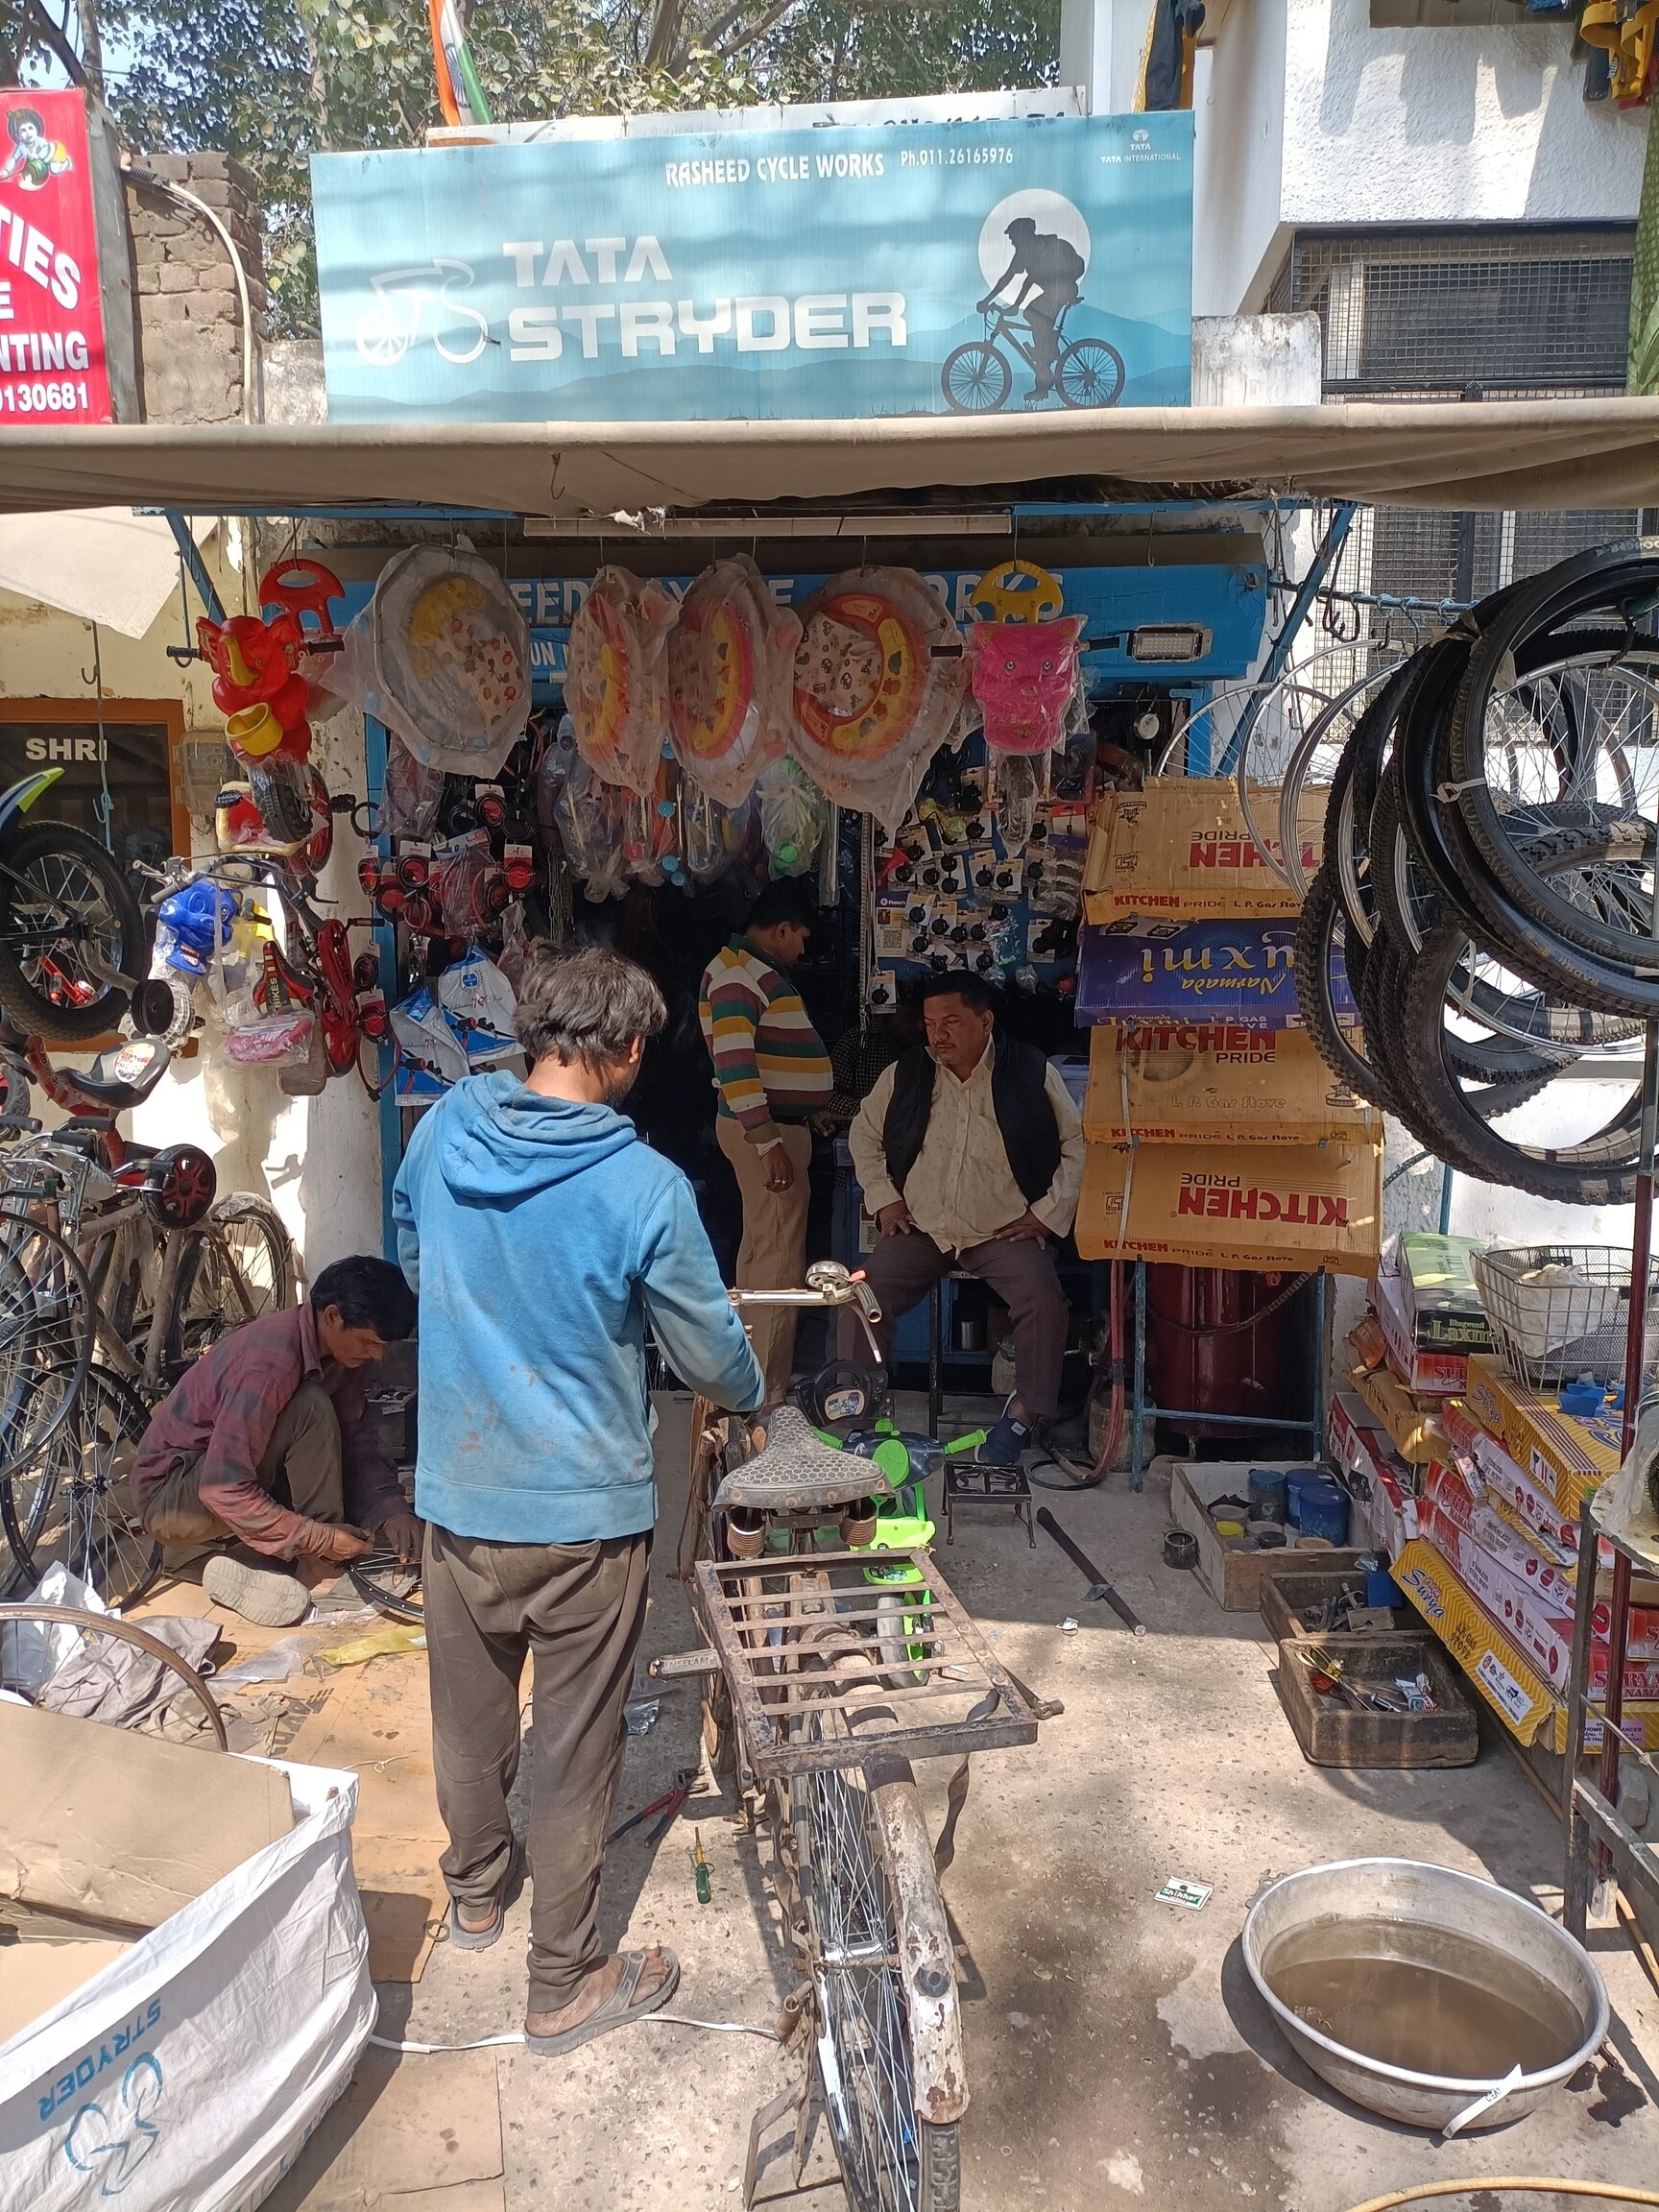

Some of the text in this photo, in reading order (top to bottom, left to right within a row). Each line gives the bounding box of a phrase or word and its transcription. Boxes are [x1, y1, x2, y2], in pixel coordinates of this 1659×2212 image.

[665, 147, 1014, 188] RASHEED CYCLE WORKS Ph.011.26165976
[1100, 153, 1181, 163] TATA INTERNATIONAL
[502, 235, 673, 287] TATA
[508, 292, 907, 362] STRYDER
[0, 381, 88, 412] 130681
[1114, 895, 1180, 908] KITCHEN
[1183, 900, 1226, 908] PRIDE
[1279, 900, 1304, 908] Stov
[273, 976, 282, 1008] BIKES
[1181, 973, 1286, 996] Narmada
[1238, 1015, 1268, 1023] GAS
[1115, 1025, 1276, 1052] KITCHEN
[1214, 1051, 1276, 1064] PRIDE
[1206, 1095, 1238, 1108] Gas
[1240, 1095, 1286, 1109] Stove
[1110, 1128, 1176, 1138] KITCHEN
[1181, 1172, 1240, 1188] PRIDE
[1177, 1187, 1349, 1228] KITCHEN
[1171, 1247, 1214, 1257] PRIDE
[1432, 1319, 1501, 1344] Laxm
[1402, 1567, 1447, 1620] Surya
[1450, 1632, 1472, 1661] STOVE
[1466, 1635, 1479, 1650] GAS
[1593, 1671, 1659, 1688] SRY
[37, 1997, 162, 2122] STRYDER
